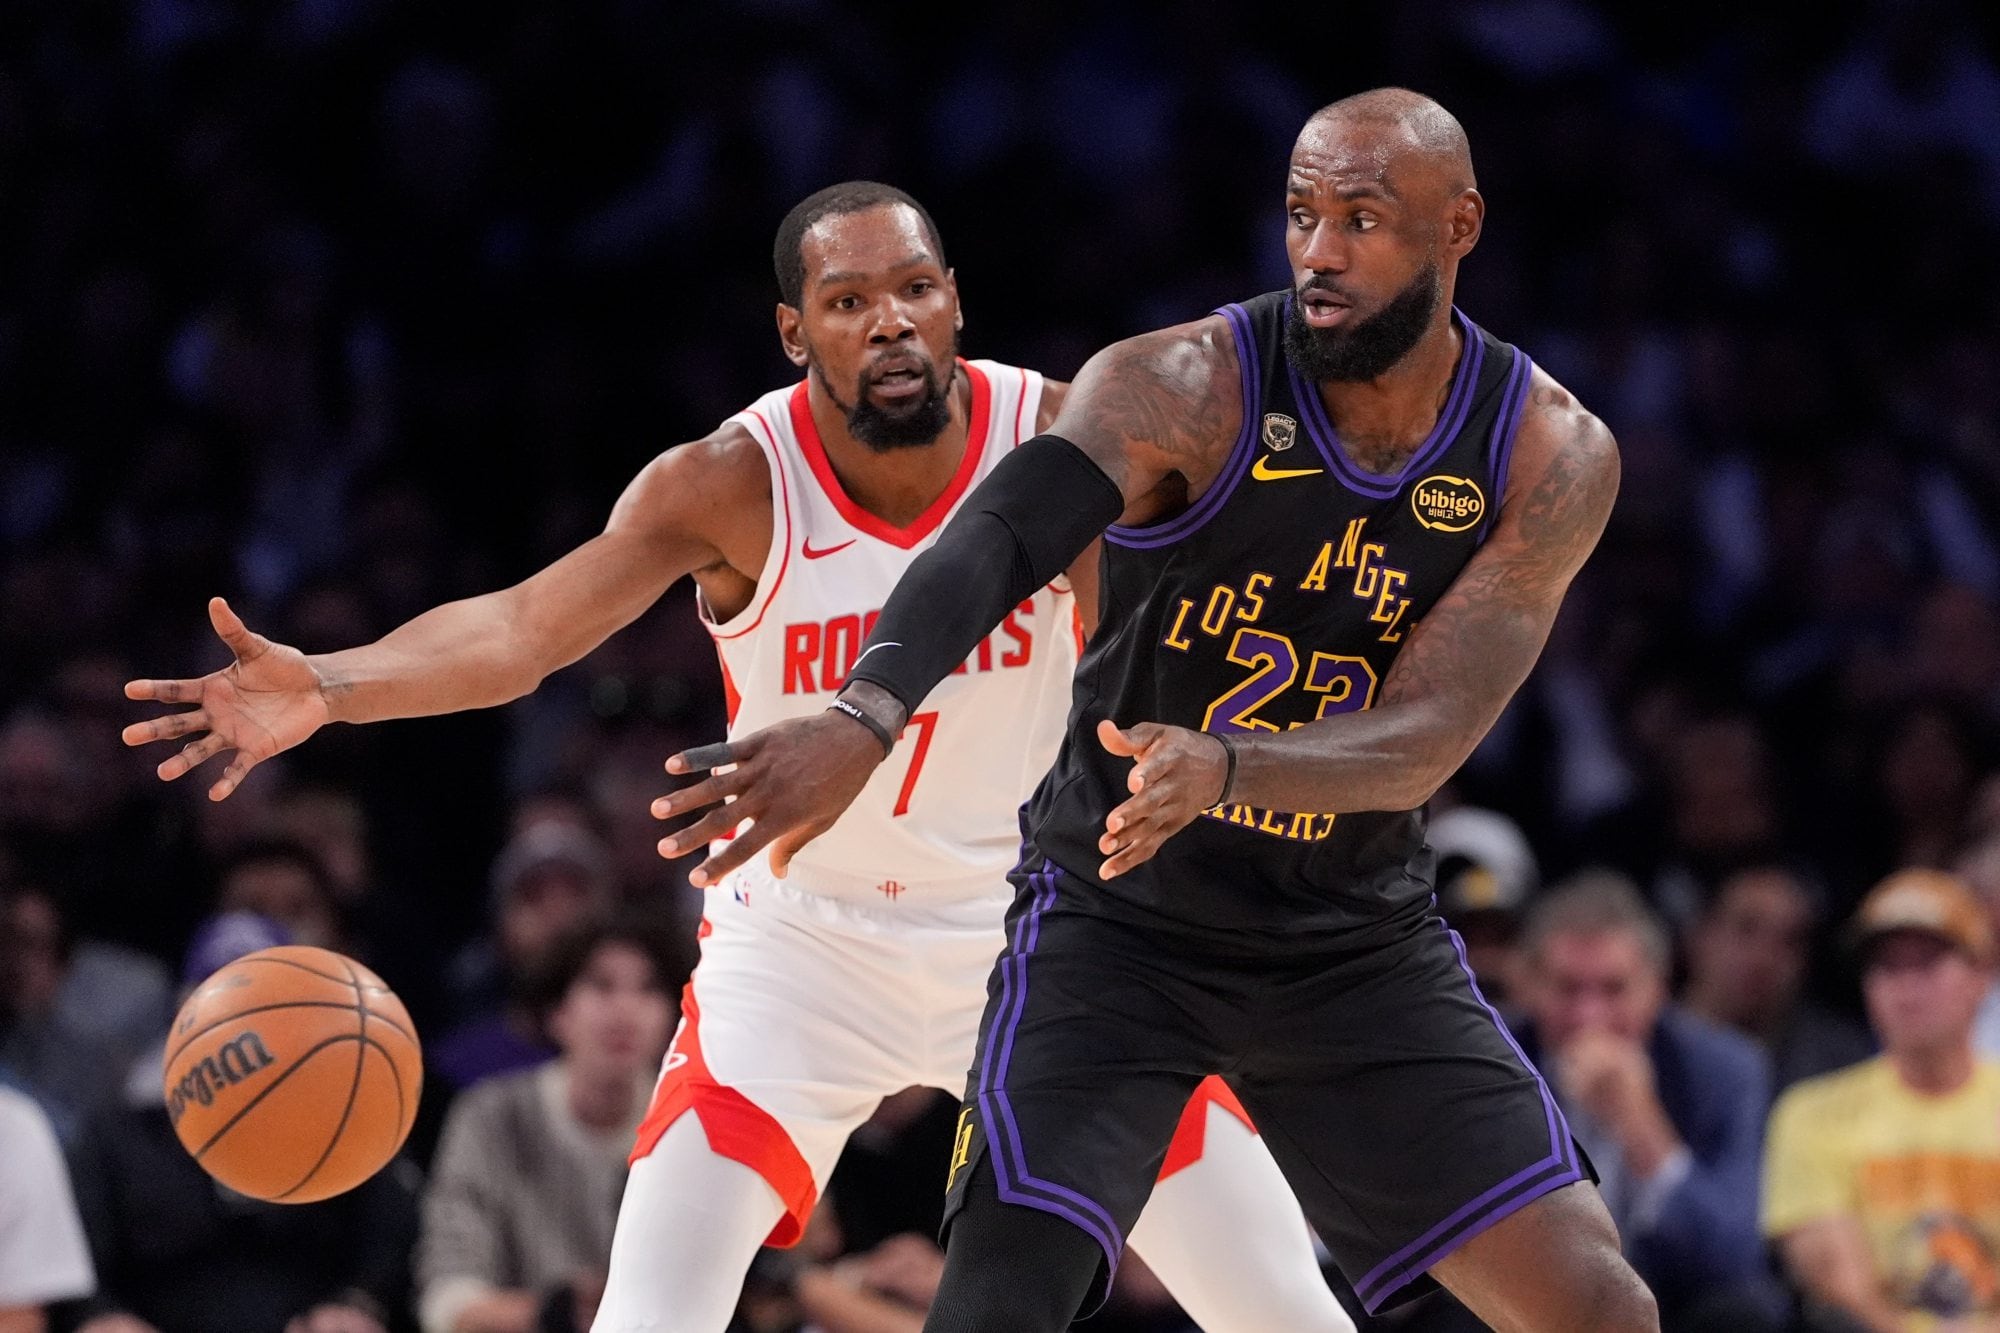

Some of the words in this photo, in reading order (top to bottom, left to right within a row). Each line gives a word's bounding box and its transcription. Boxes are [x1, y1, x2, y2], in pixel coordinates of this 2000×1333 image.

[1267, 415, 1293, 427] LEGACY
[1418, 488, 1480, 517] bibigo
[1428, 507, 1455, 520] 비비고
[1163, 572, 1275, 652] LOS
[1299, 516, 1418, 644] ANGEL
[1200, 626, 1378, 735] 23
[893, 710, 940, 818] 7
